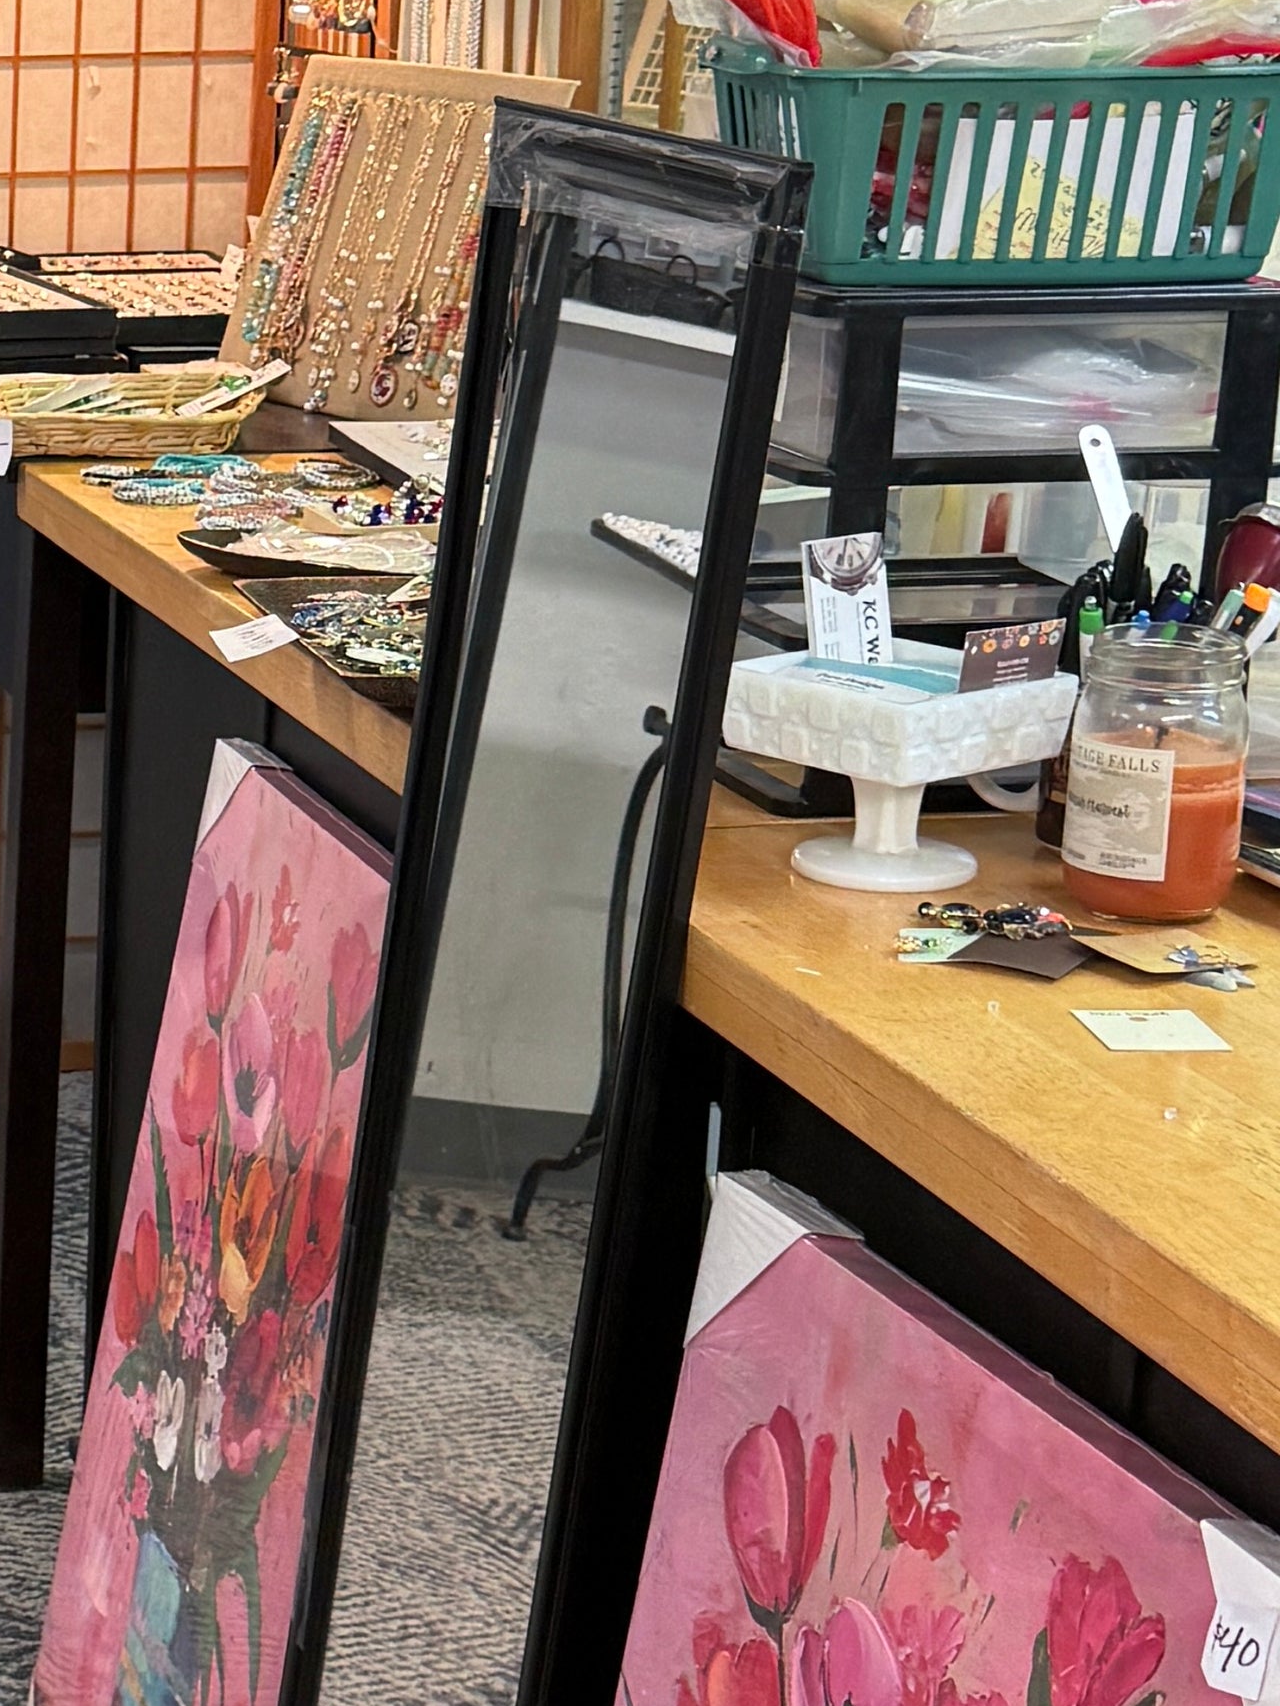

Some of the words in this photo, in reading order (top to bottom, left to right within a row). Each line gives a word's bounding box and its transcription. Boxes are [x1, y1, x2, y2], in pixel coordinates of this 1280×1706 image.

[861, 599, 879, 631] KC
[1107, 753, 1162, 774] FALLS
[1212, 1614, 1261, 1674] $40
